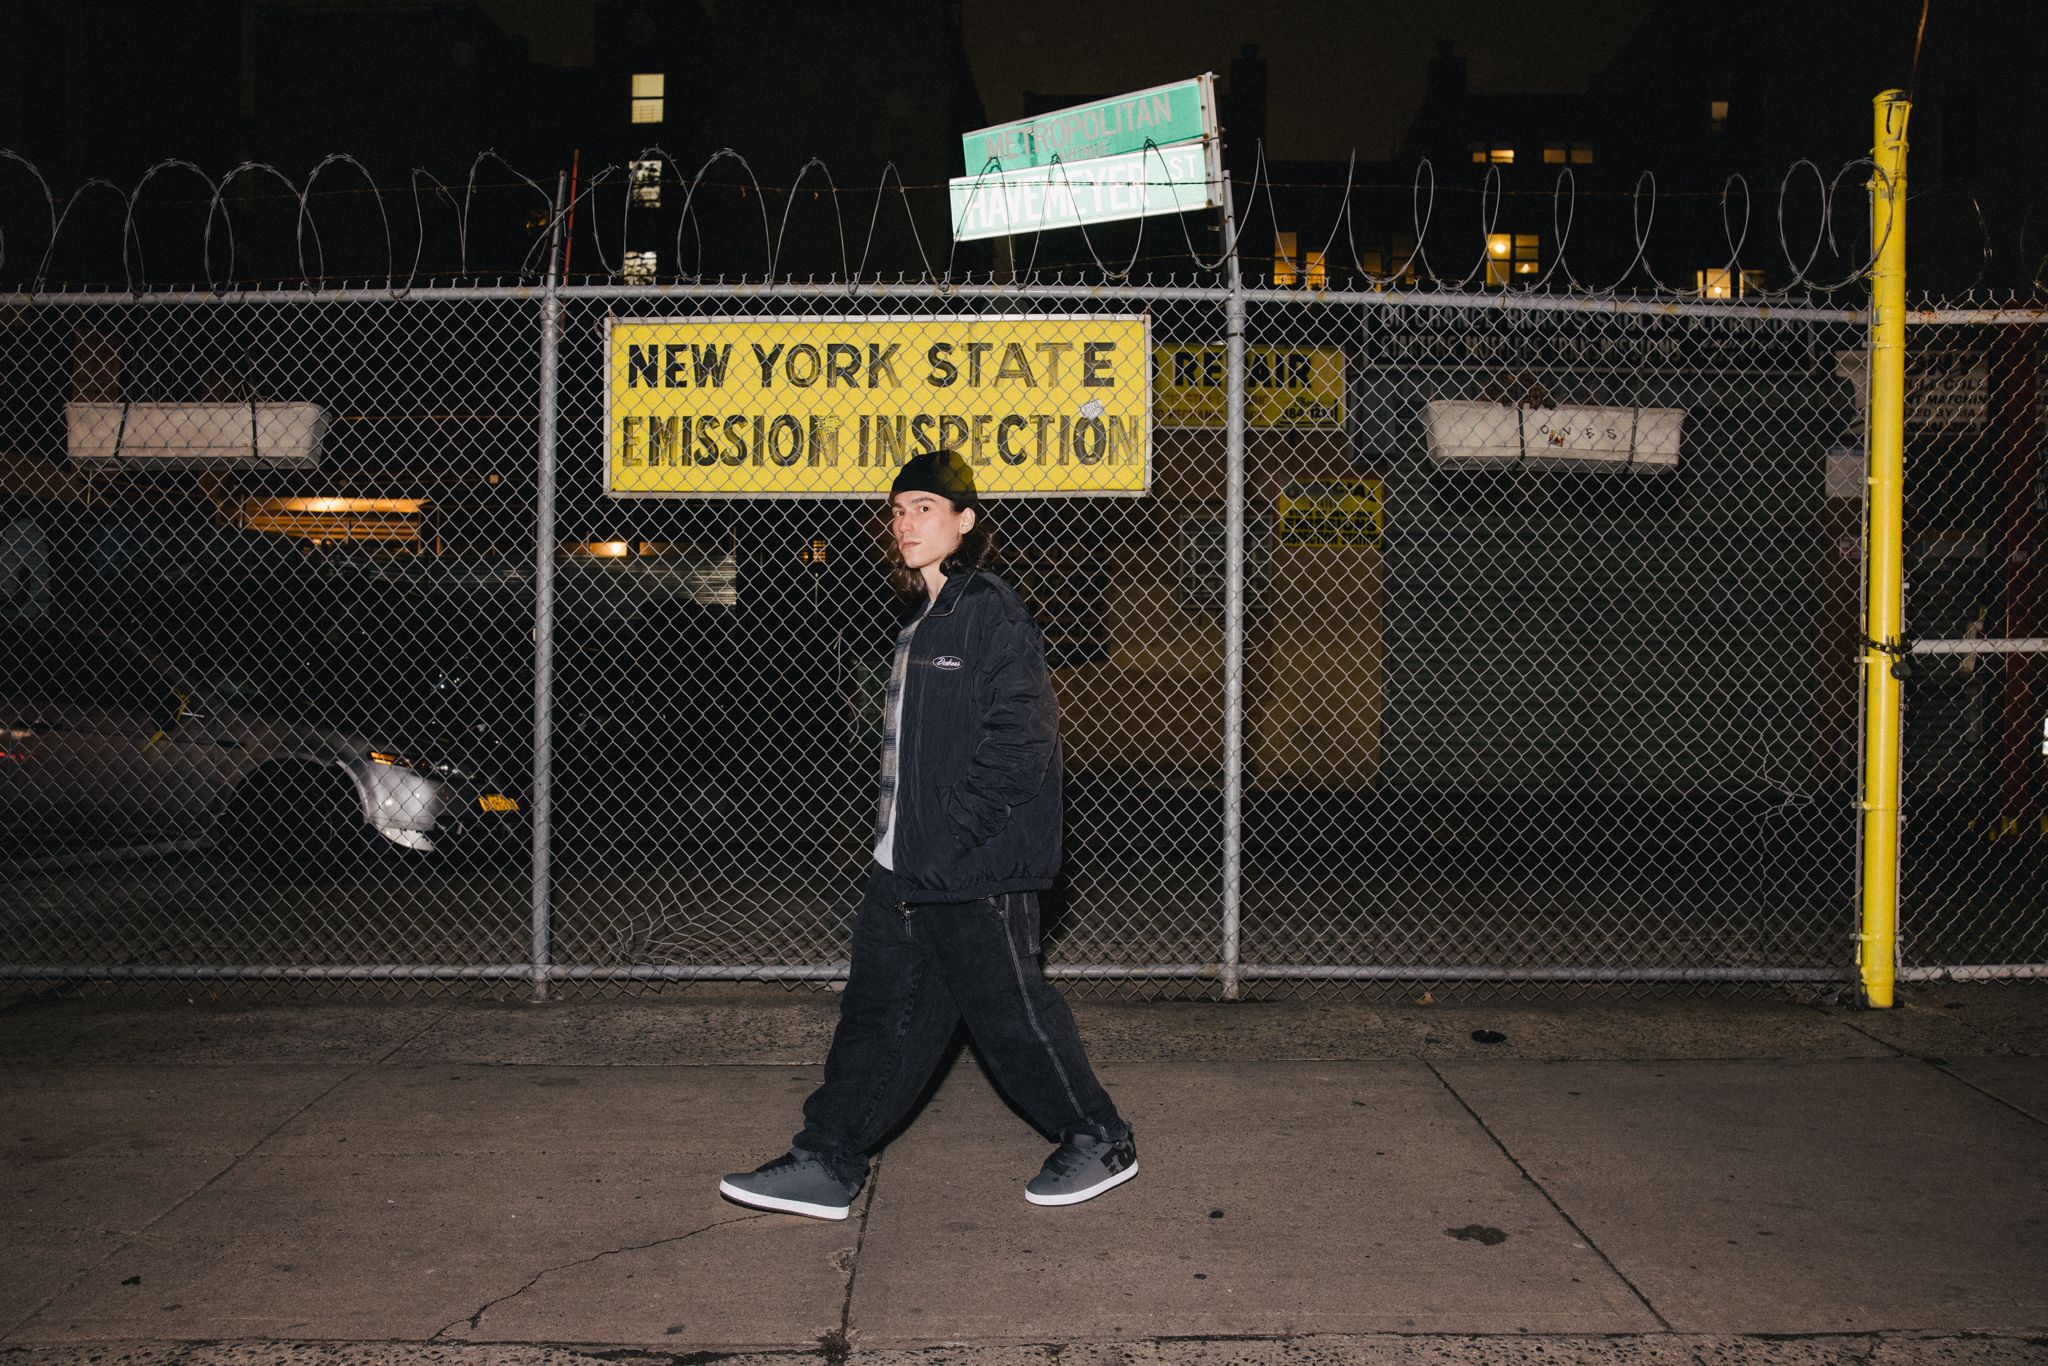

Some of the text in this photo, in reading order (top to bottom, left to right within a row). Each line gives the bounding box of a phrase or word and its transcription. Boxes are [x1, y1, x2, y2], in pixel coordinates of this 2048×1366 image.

[985, 93, 1173, 161] METROPOLITAN
[965, 154, 1198, 231] HAVEMEYER ST
[627, 343, 730, 388] NEW
[751, 343, 904, 389] YORK
[927, 342, 1116, 388] STATE
[1173, 351, 1312, 389] REAIR
[621, 414, 1140, 467] EMISSION INSPECTION
